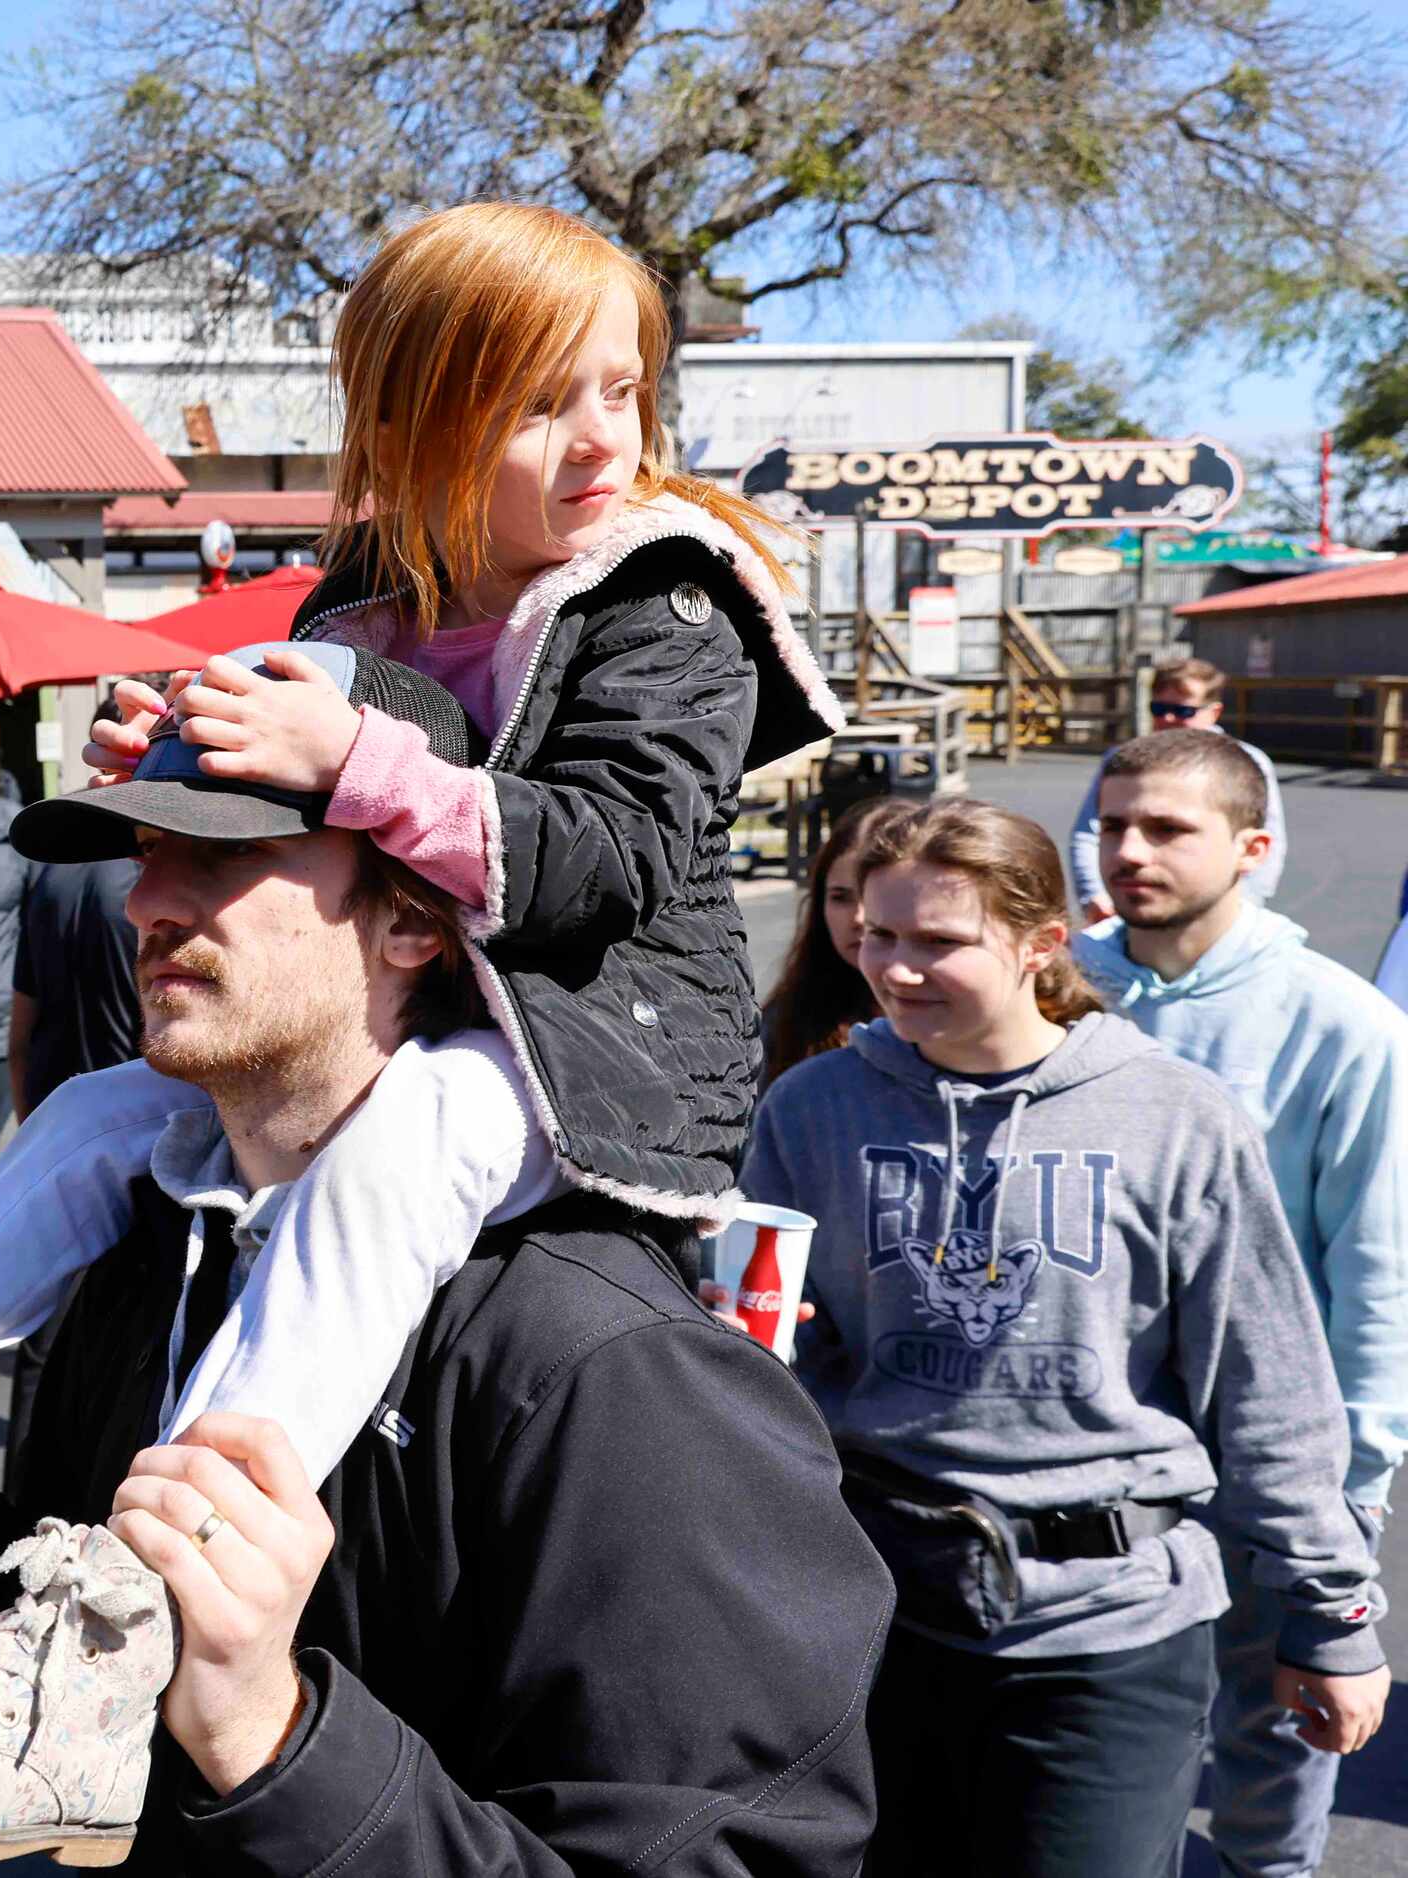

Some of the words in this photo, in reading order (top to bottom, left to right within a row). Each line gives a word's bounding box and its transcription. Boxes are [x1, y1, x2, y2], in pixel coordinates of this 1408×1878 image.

[786, 447, 1197, 491] BOOMTOWN
[877, 484, 1103, 520] DEPOT
[860, 1143, 1120, 1282] BYU
[894, 1339, 1080, 1391] COUGARS
